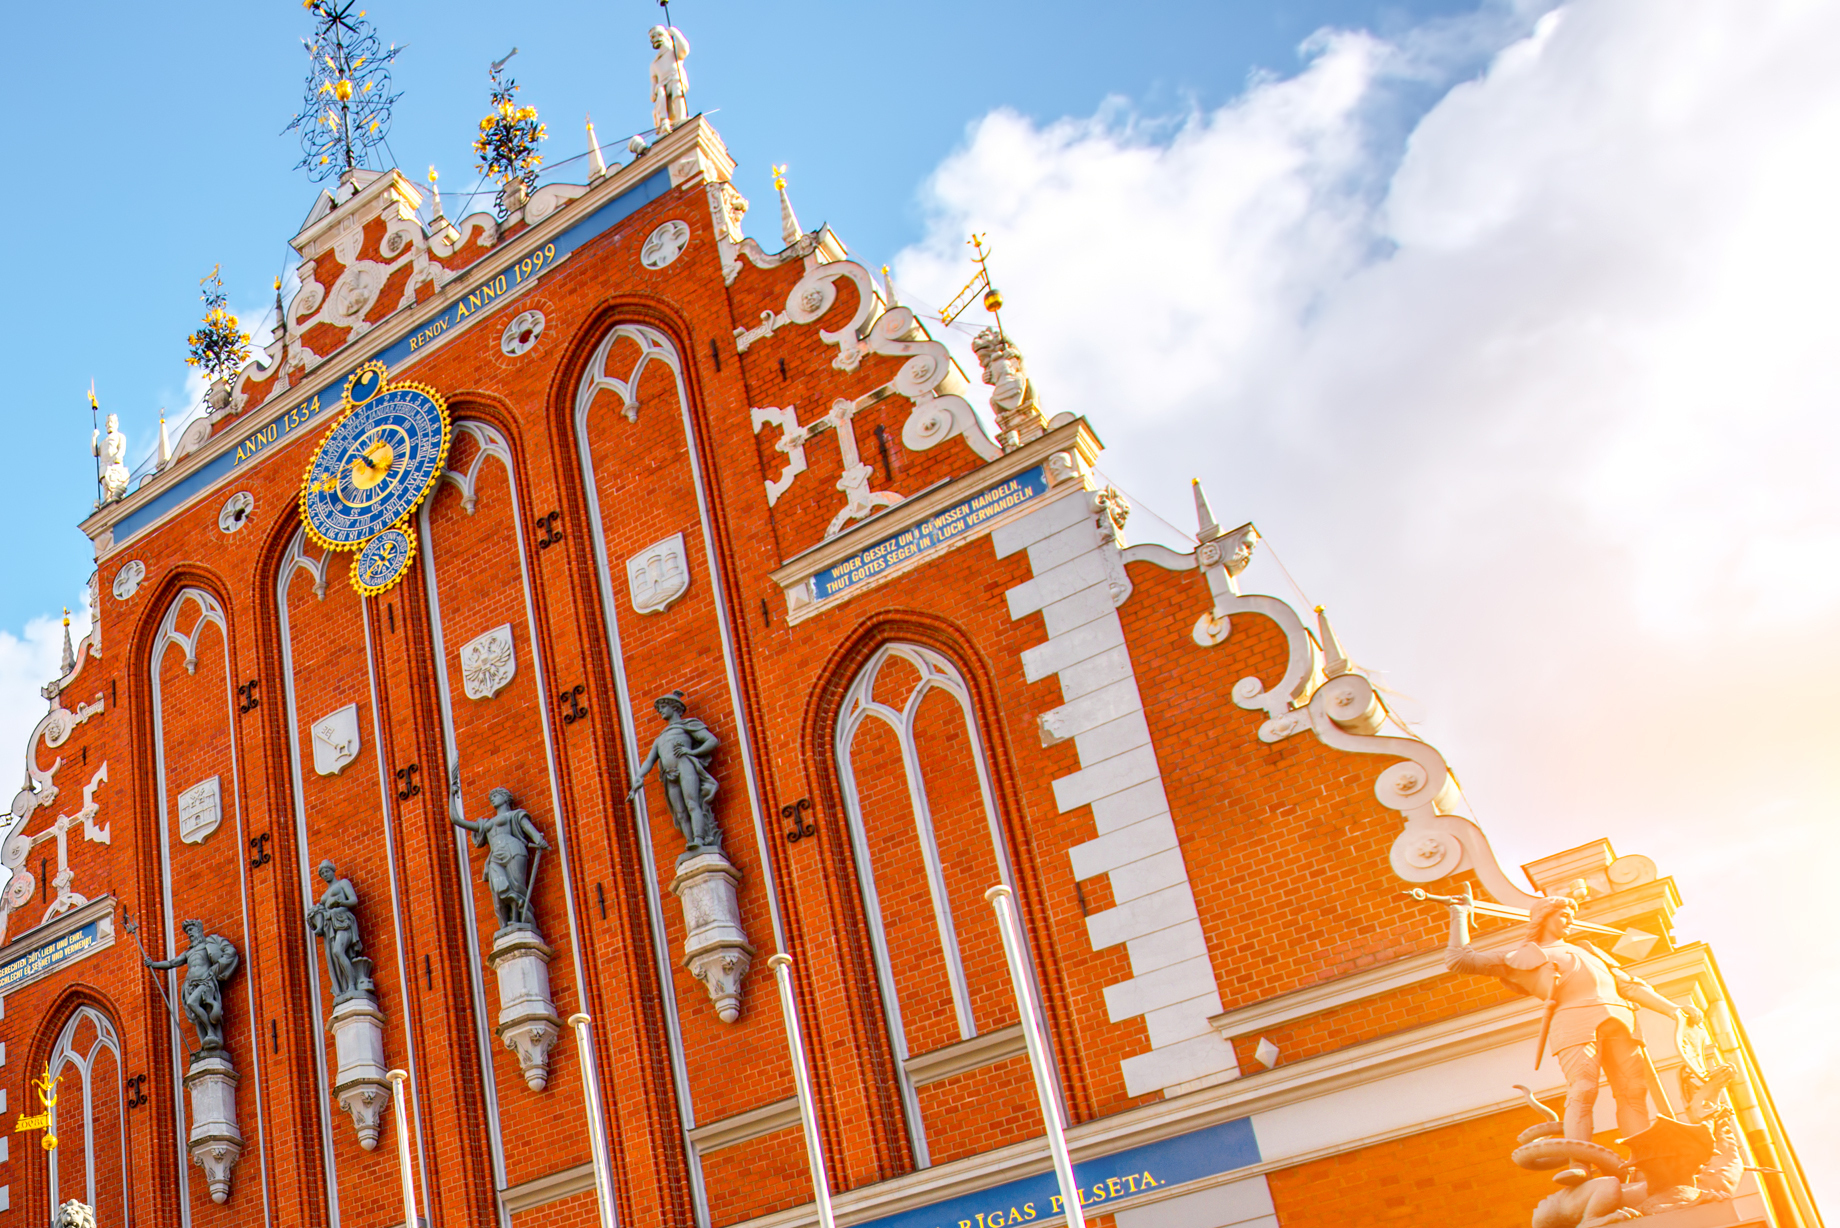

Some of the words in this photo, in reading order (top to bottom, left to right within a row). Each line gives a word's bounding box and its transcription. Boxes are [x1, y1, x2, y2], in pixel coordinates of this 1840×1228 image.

[233, 423, 278, 466] ANNO
[283, 395, 321, 433] 1334
[409, 316, 450, 352] RENOV.
[455, 274, 507, 323] ANNO
[514, 243, 556, 285] 1999
[826, 575, 849, 594] THUT
[851, 558, 886, 583] GOTTES
[887, 543, 918, 565] SEGEN
[919, 537, 931, 550] IN
[966, 486, 1033, 526] VERWANDELN
[831, 557, 862, 578] WIDER
[863, 539, 897, 563] GESETZ
[31, 956, 51, 971] SENET
[52, 950, 63, 962] UND
[64, 935, 92, 956] VERMEHRT
[41, 944, 56, 957] LIEBT
[56, 937, 69, 950] UND
[1049, 1171, 1166, 1214] PLSĒTA.
